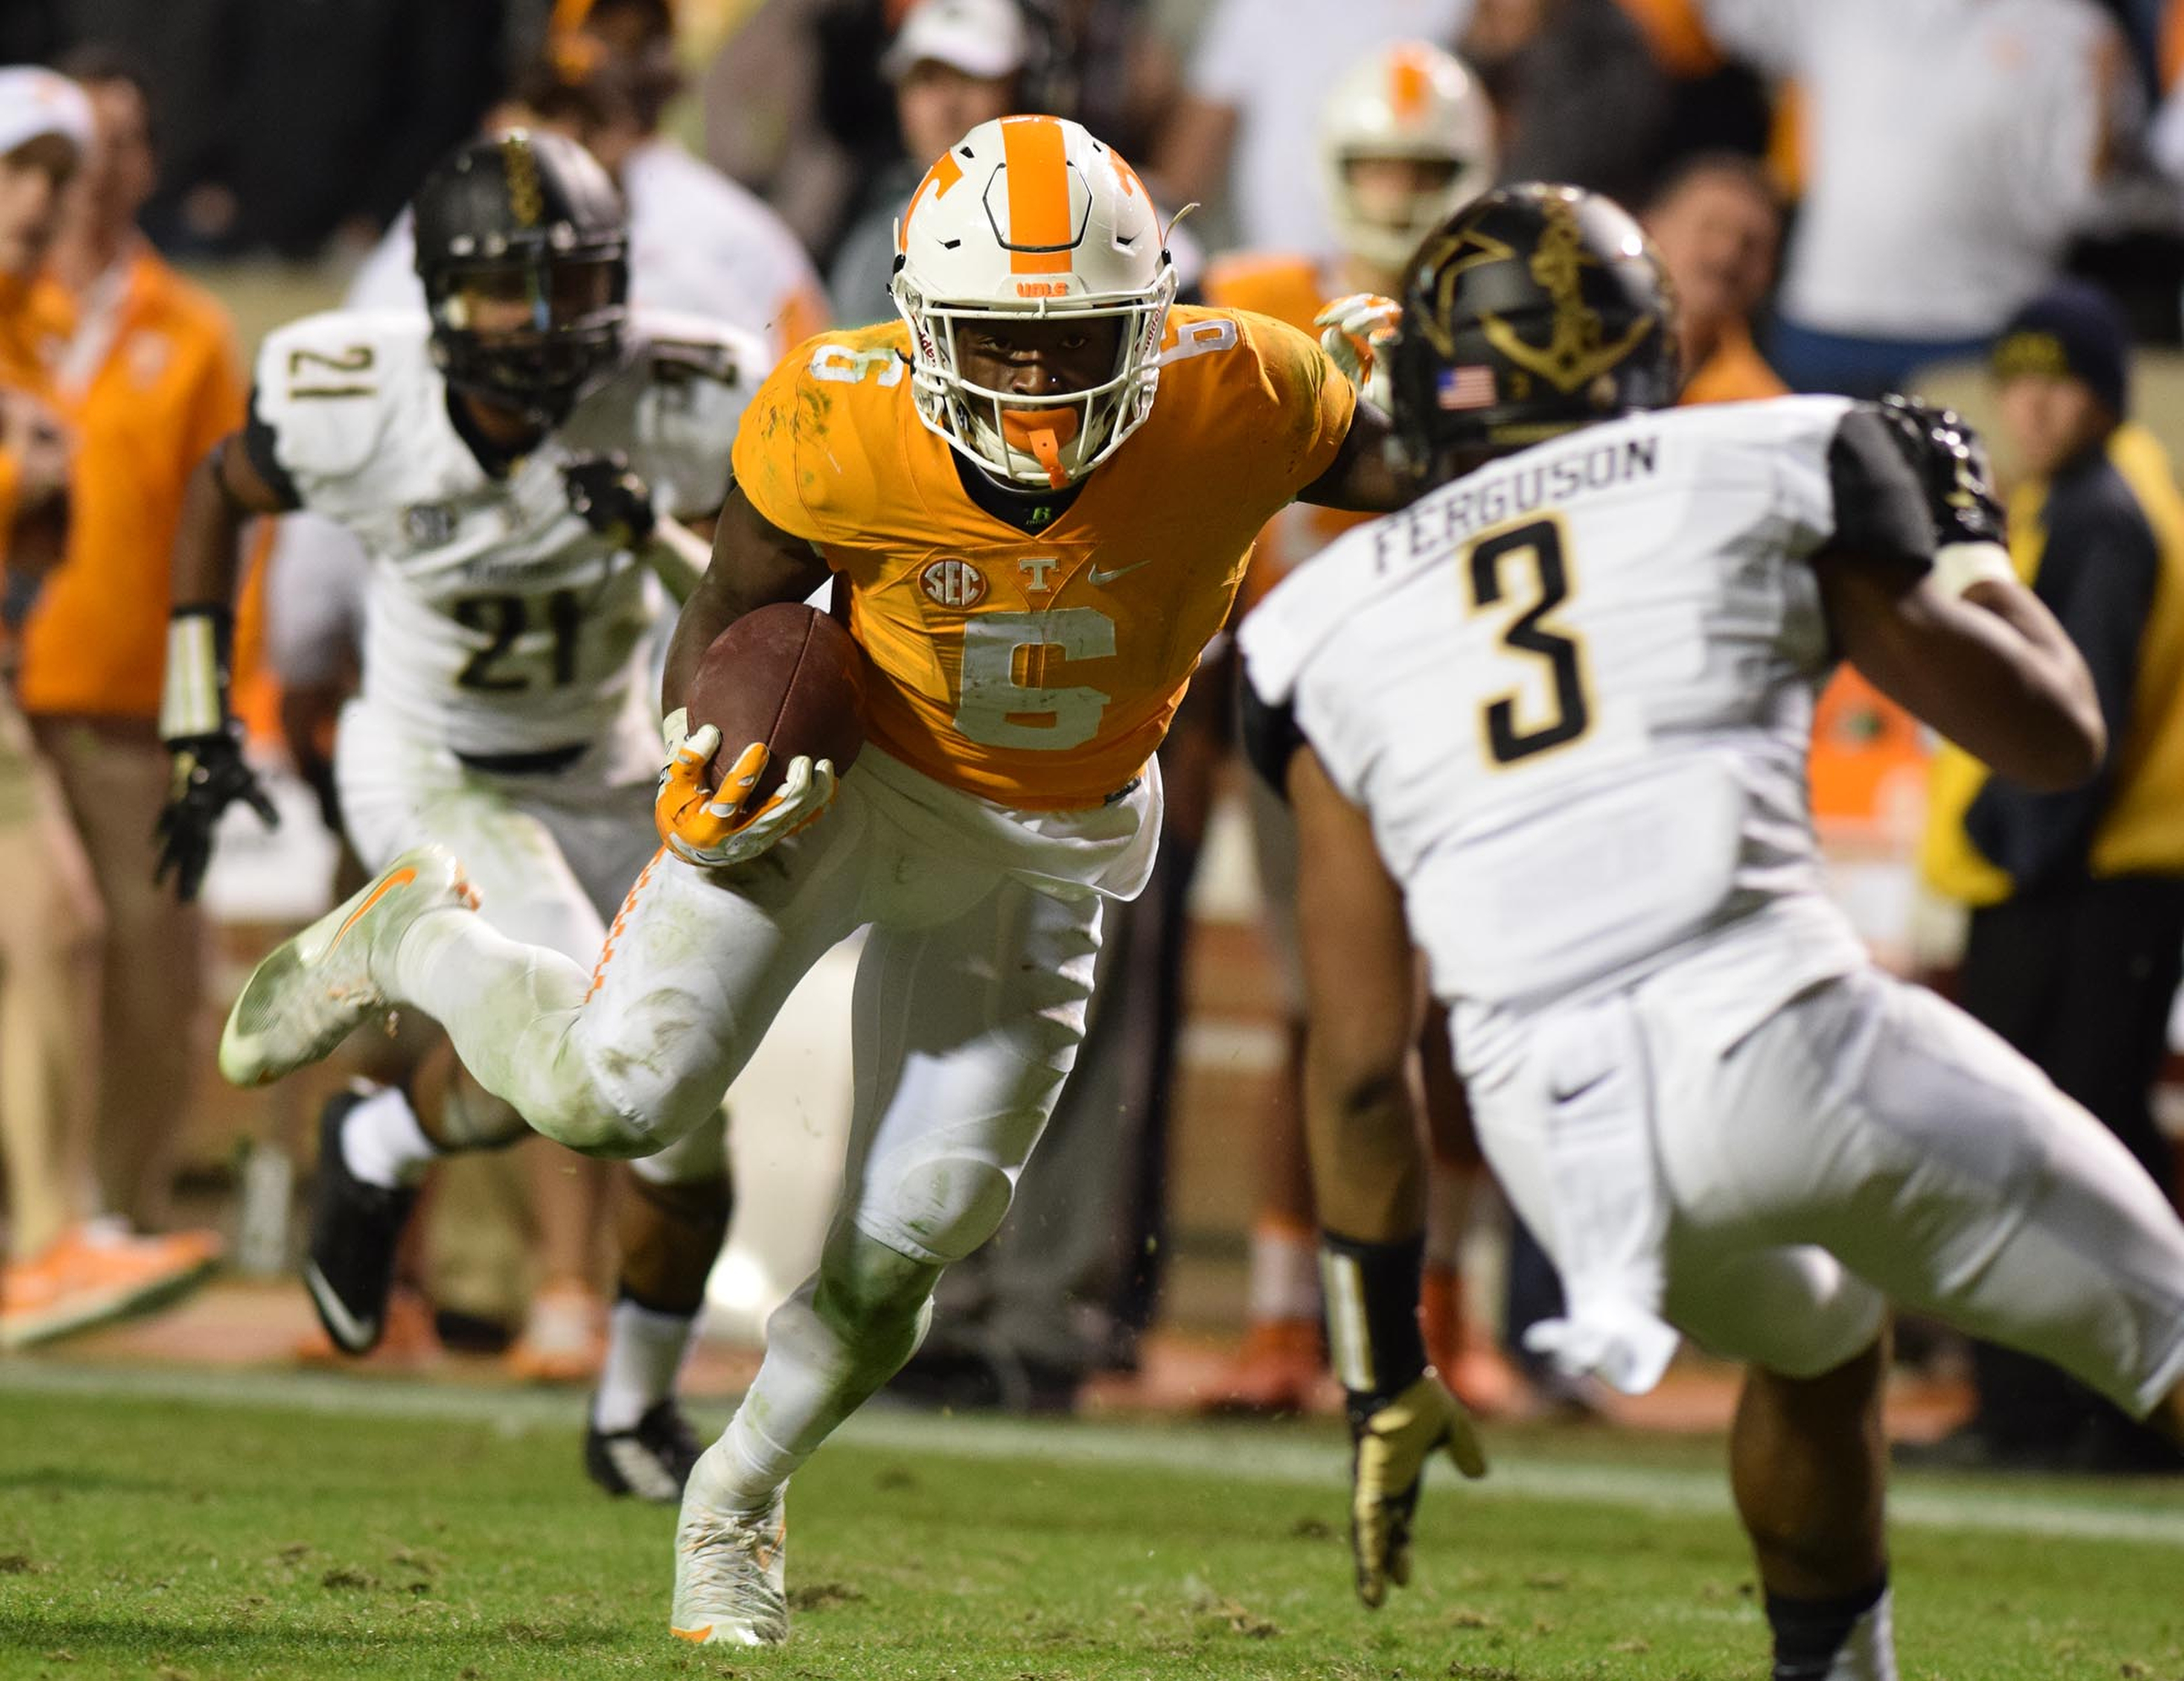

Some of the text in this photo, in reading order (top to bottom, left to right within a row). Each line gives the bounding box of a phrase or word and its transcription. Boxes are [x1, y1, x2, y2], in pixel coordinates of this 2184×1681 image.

[1016, 281, 1067, 298] VOLS
[288, 345, 378, 401] 21
[809, 344, 905, 388] 6
[1373, 437, 1660, 574] FERGUSON
[925, 561, 980, 606] SEC
[1018, 557, 1059, 592] T
[455, 586, 578, 691] 21
[1461, 512, 1597, 772] 3
[952, 606, 1117, 751] 6
